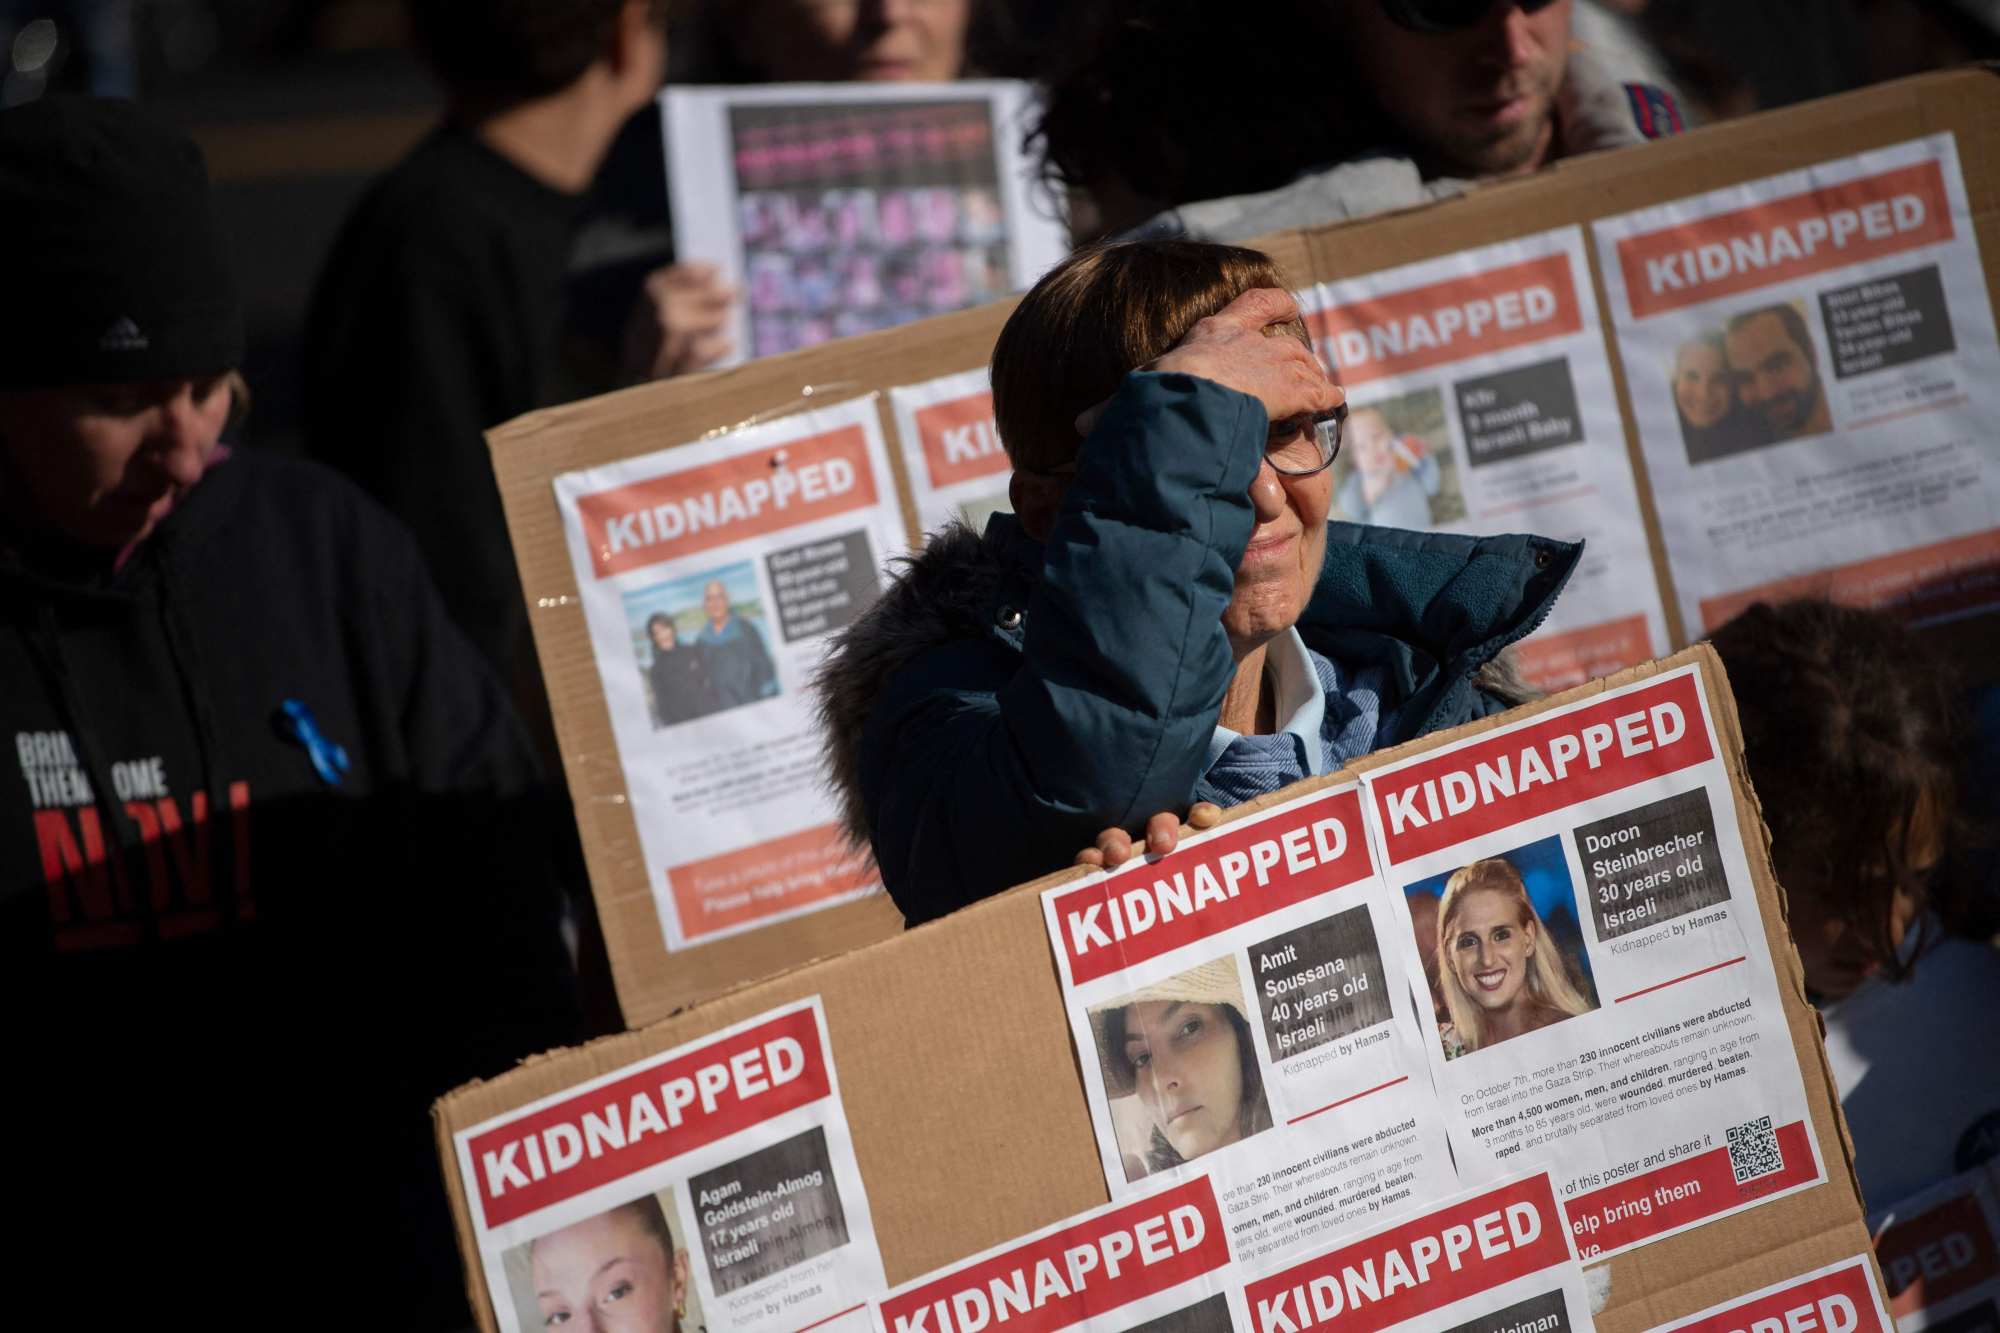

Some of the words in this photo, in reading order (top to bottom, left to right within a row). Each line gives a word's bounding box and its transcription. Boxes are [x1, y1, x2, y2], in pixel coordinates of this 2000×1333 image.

[1645, 195, 1926, 294] KIDNAPPED
[1312, 285, 1556, 371] IDNAPPED
[605, 458, 855, 554] KIDNAPPED
[1384, 701, 1687, 835] KIDNAPPED
[1585, 824, 1641, 854] Doron
[1592, 830, 1705, 879] Steinbrecher
[1067, 817, 1348, 955] KIDNAPPED
[1598, 883, 1619, 904] 30
[1623, 869, 1672, 900] years
[1676, 855, 1704, 878] old
[1603, 897, 1657, 930] Israeli
[1610, 928, 1670, 956] Kidnapped
[1672, 923, 1686, 936] by
[1688, 910, 1728, 930] Hamas
[1260, 944, 1298, 973] Amit
[1265, 957, 1346, 998] Soussana
[1271, 1003, 1291, 1023] 40
[1294, 988, 1339, 1019] years
[1342, 972, 1369, 997] old
[1276, 1016, 1326, 1050] Israeli
[1282, 1049, 1338, 1077] Kidnapped
[1339, 1043, 1352, 1056] by
[1355, 1029, 1390, 1050] Hamas
[1461, 1094, 1474, 1106] On
[1476, 1080, 1511, 1099] October
[1513, 1073, 1531, 1086] 7th,
[1532, 1065, 1555, 1081] more
[1557, 1057, 1578, 1073] than
[1579, 1050, 1597, 1064] 230
[1599, 1034, 1641, 1058] innocent
[1642, 1023, 1681, 1043] civilians
[1682, 1014, 1706, 1029] were
[1707, 997, 1752, 1021] abducted
[1464, 1104, 1485, 1119] from
[1486, 1095, 1510, 1111] Israel
[1511, 1089, 1528, 1104] into
[1529, 1084, 1544, 1097] the
[1545, 1075, 1571, 1090] Gaza
[1598, 1056, 1621, 1072] Their
[1622, 1039, 1680, 1064] whereabouts
[1681, 1027, 1711, 1044] remain
[1471, 1123, 1495, 1138] More
[1495, 1114, 1517, 1131] than
[1518, 1104, 1543, 1122] 4,500
[1544, 1093, 1583, 1112] women,
[1584, 1083, 1609, 1099] men,
[1610, 1075, 1629, 1091] and
[1630, 1063, 1672, 1084] children,
[1673, 1050, 1708, 1069] ranging
[1709, 1045, 1718, 1055] in
[1720, 1040, 1738, 1053] age
[1739, 1031, 1761, 1046] from
[482, 1036, 805, 1198] KIDNAPPED
[1484, 1138, 1491, 1149] 3
[1492, 1126, 1524, 1144] months
[1525, 1123, 1535, 1135] to
[1536, 1118, 1548, 1130] 85
[1549, 1110, 1575, 1127] years
[1577, 1103, 1594, 1116] old,
[1595, 1096, 1618, 1111] were
[1526, 1136, 1544, 1150] and
[1545, 1122, 1578, 1143] brutally
[1580, 1107, 1625, 1130] separated
[1626, 1100, 1648, 1113] from
[1649, 1091, 1674, 1107] loved
[1676, 1084, 1699, 1097] ones
[1699, 1079, 1712, 1091] by
[1714, 1066, 1749, 1084] Hamas.
[1222, 1190, 1235, 1202] ore
[1236, 1182, 1256, 1195] than
[1257, 1173, 1271, 1188] 230
[1272, 1158, 1312, 1181] innocent
[1312, 1145, 1350, 1166] civilians
[1351, 1136, 1373, 1150] were
[1375, 1117, 1416, 1142] abducted
[1227, 1201, 1249, 1215] Gaza
[1272, 1181, 1293, 1196] Their
[1295, 1161, 1348, 1187] whereabouts
[1349, 1149, 1378, 1166] remain
[1566, 1182, 1577, 1195] of
[1579, 1173, 1601, 1190] this
[1603, 1159, 1641, 1184] poster
[1643, 1150, 1666, 1168] and
[1669, 1138, 1701, 1159] share
[1703, 1134, 1713, 1147] it
[700, 1180, 742, 1207] Agam
[704, 1170, 823, 1226] Goldstein-Almog
[1232, 1217, 1260, 1234] omen,
[1262, 1208, 1283, 1223] men,
[1284, 1199, 1302, 1214] and
[1343, 1172, 1376, 1190] ranging
[1377, 1168, 1385, 1177] in
[1386, 1161, 1402, 1174] age
[1403, 1152, 1423, 1166] from
[1571, 1214, 1600, 1235] elp
[1603, 1197, 1652, 1225] bring
[1654, 1178, 1702, 1207] them
[709, 1229, 727, 1248] 17
[729, 1216, 769, 1243] years
[772, 1202, 795, 1222] old
[1235, 1235, 1253, 1249] ears
[1272, 1219, 1292, 1233] were
[1238, 1248, 1255, 1263] tally
[1257, 1232, 1300, 1255] separated
[1300, 1223, 1320, 1237] from
[1321, 1213, 1345, 1230] loved
[1346, 1206, 1367, 1220] ones
[1368, 1201, 1380, 1212] by
[1579, 1243, 1606, 1260] ve.
[713, 1239, 759, 1269] Israeli
[894, 1204, 1206, 1333] KIDNAPPED
[1257, 1201, 1542, 1333] KIDNAPPED
[765, 1302, 780, 1315] by
[783, 1283, 823, 1307] Hamas
[1493, 1313, 1559, 1333] iman
